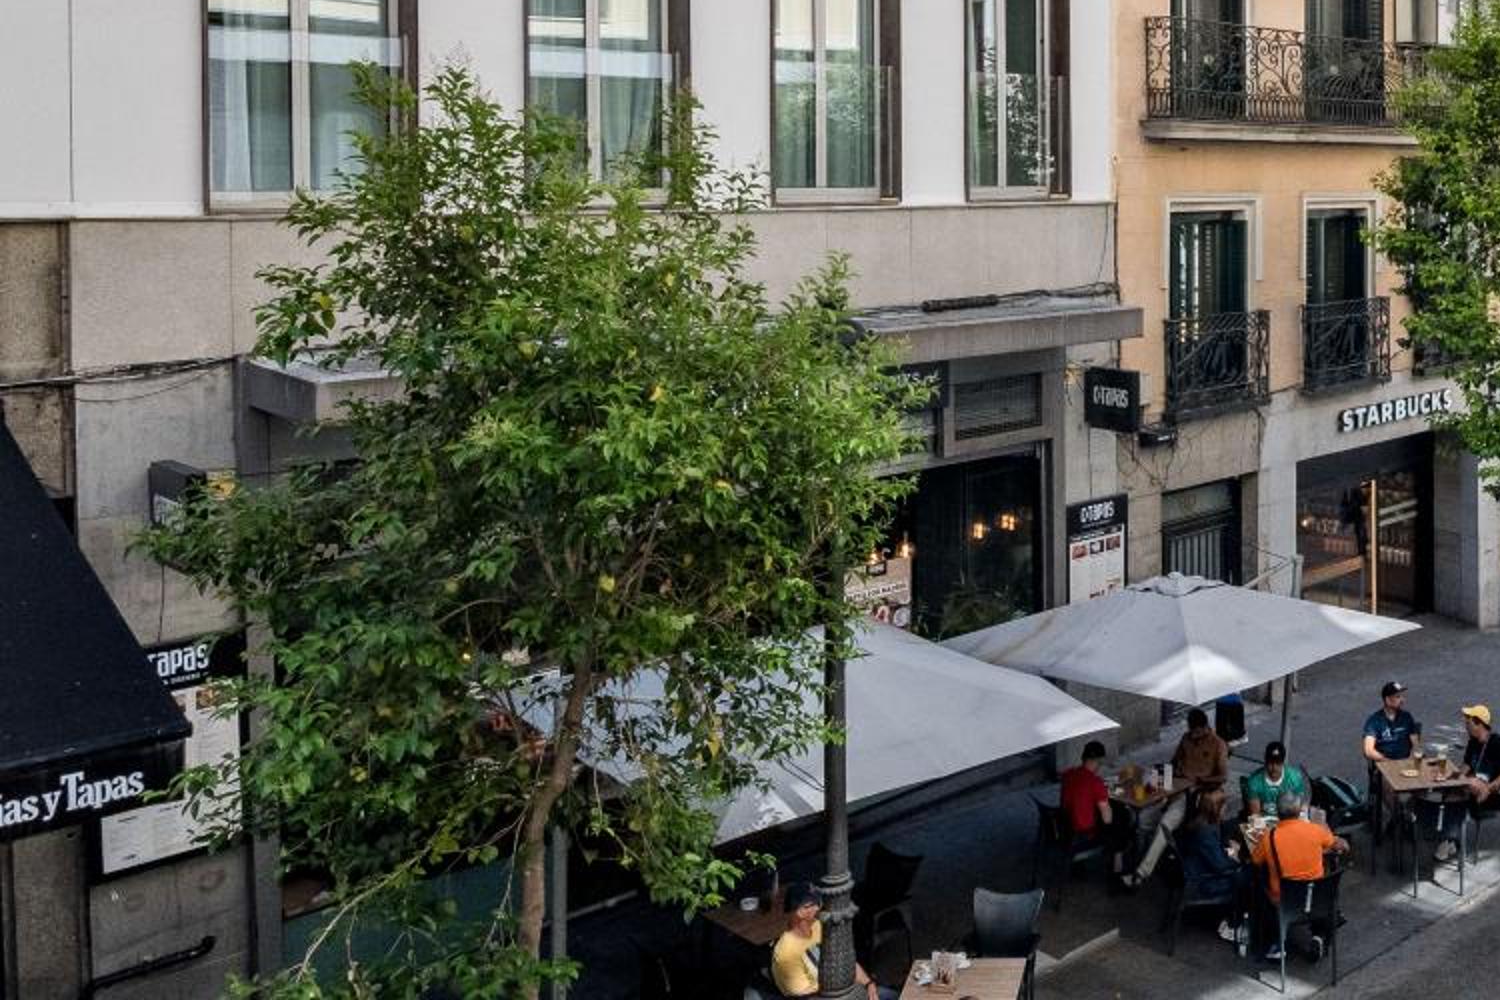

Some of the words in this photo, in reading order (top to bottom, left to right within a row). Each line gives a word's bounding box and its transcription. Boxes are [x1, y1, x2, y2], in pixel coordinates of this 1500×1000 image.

[1342, 388, 1453, 432] STARBUCKS
[41, 790, 62, 822] y
[60, 770, 145, 812] Tapas
